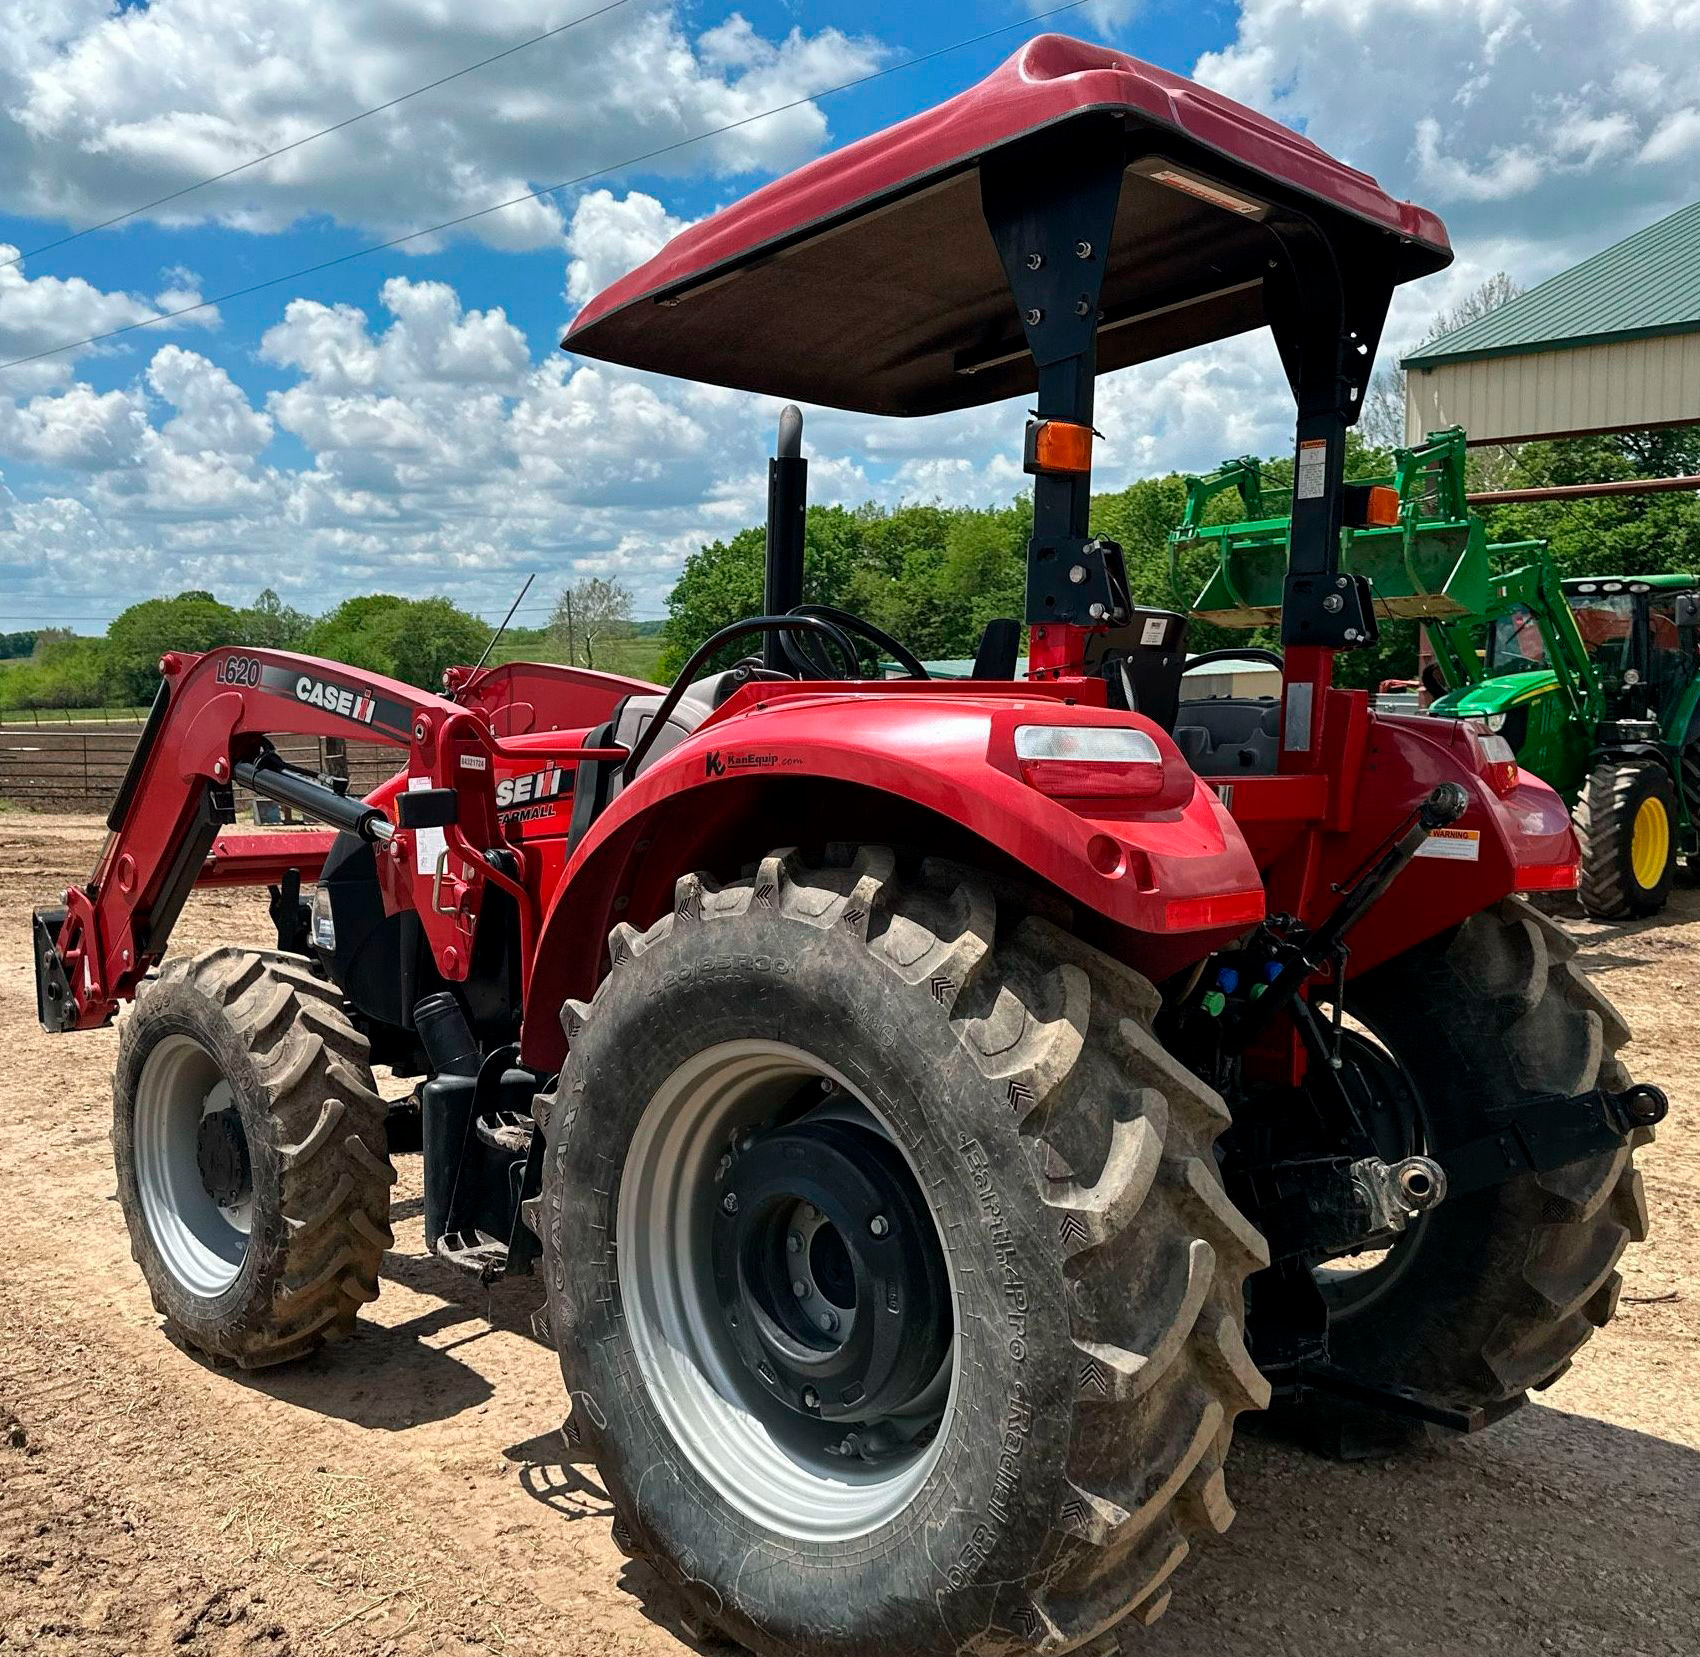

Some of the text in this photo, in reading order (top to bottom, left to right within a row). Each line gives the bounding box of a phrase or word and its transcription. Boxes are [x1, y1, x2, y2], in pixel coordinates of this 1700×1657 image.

[216, 656, 263, 688] L620
[296, 676, 353, 715] CASE
[495, 775, 533, 806] SE
[1433, 830, 1469, 839] WARNING
